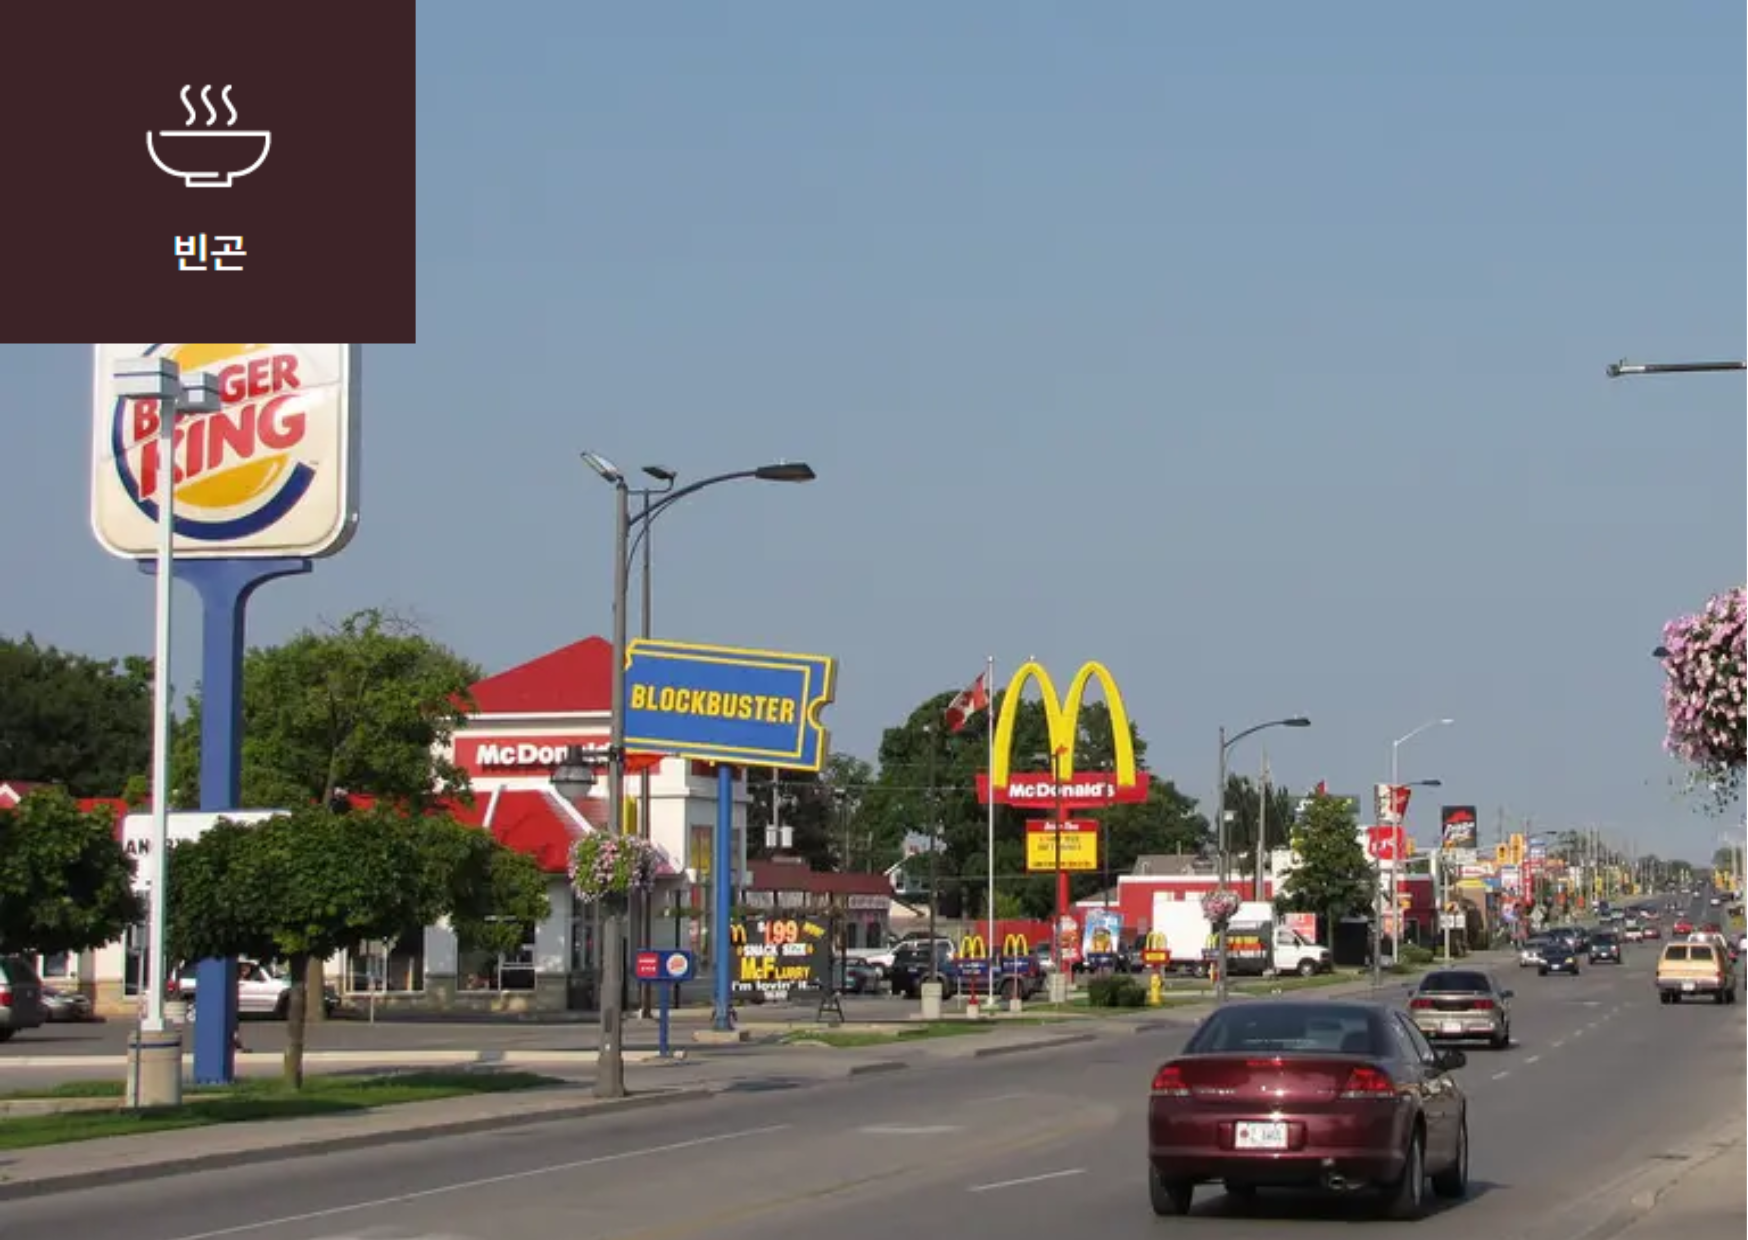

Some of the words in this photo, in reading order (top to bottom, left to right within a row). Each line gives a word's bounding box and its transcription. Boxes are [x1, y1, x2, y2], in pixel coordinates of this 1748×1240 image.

[134, 354, 301, 441] BGER
[630, 684, 796, 724] BLOCKBUSTER
[1009, 782, 1116, 798] McDonald's
